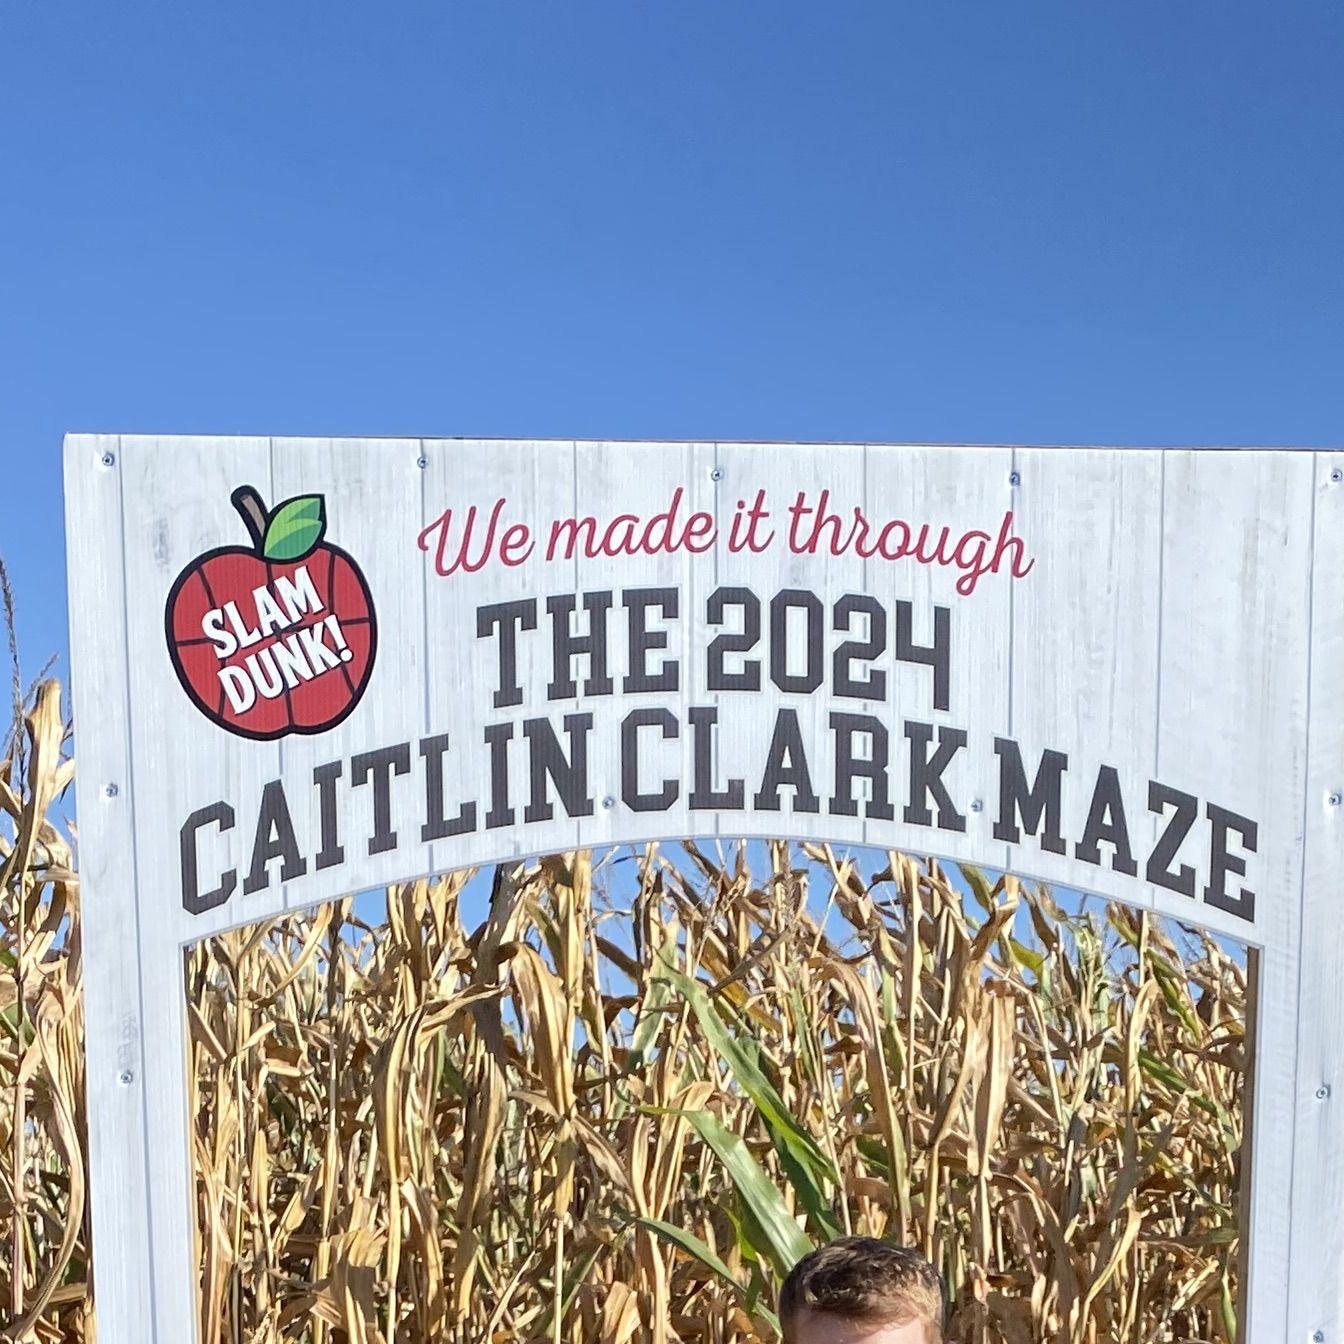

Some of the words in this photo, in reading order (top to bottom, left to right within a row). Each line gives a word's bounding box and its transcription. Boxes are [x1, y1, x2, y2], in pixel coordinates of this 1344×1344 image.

[418, 497, 535, 577] We
[545, 487, 718, 563] made
[726, 488, 775, 553] it
[786, 488, 1035, 596] through
[201, 565, 325, 660] SLAM
[217, 615, 353, 715] DUNK!
[477, 587, 680, 708] THE
[706, 587, 950, 710] 2024
[180, 711, 594, 915] CAITLIN
[619, 706, 969, 832] CLARK
[991, 737, 1259, 922] MAZE
